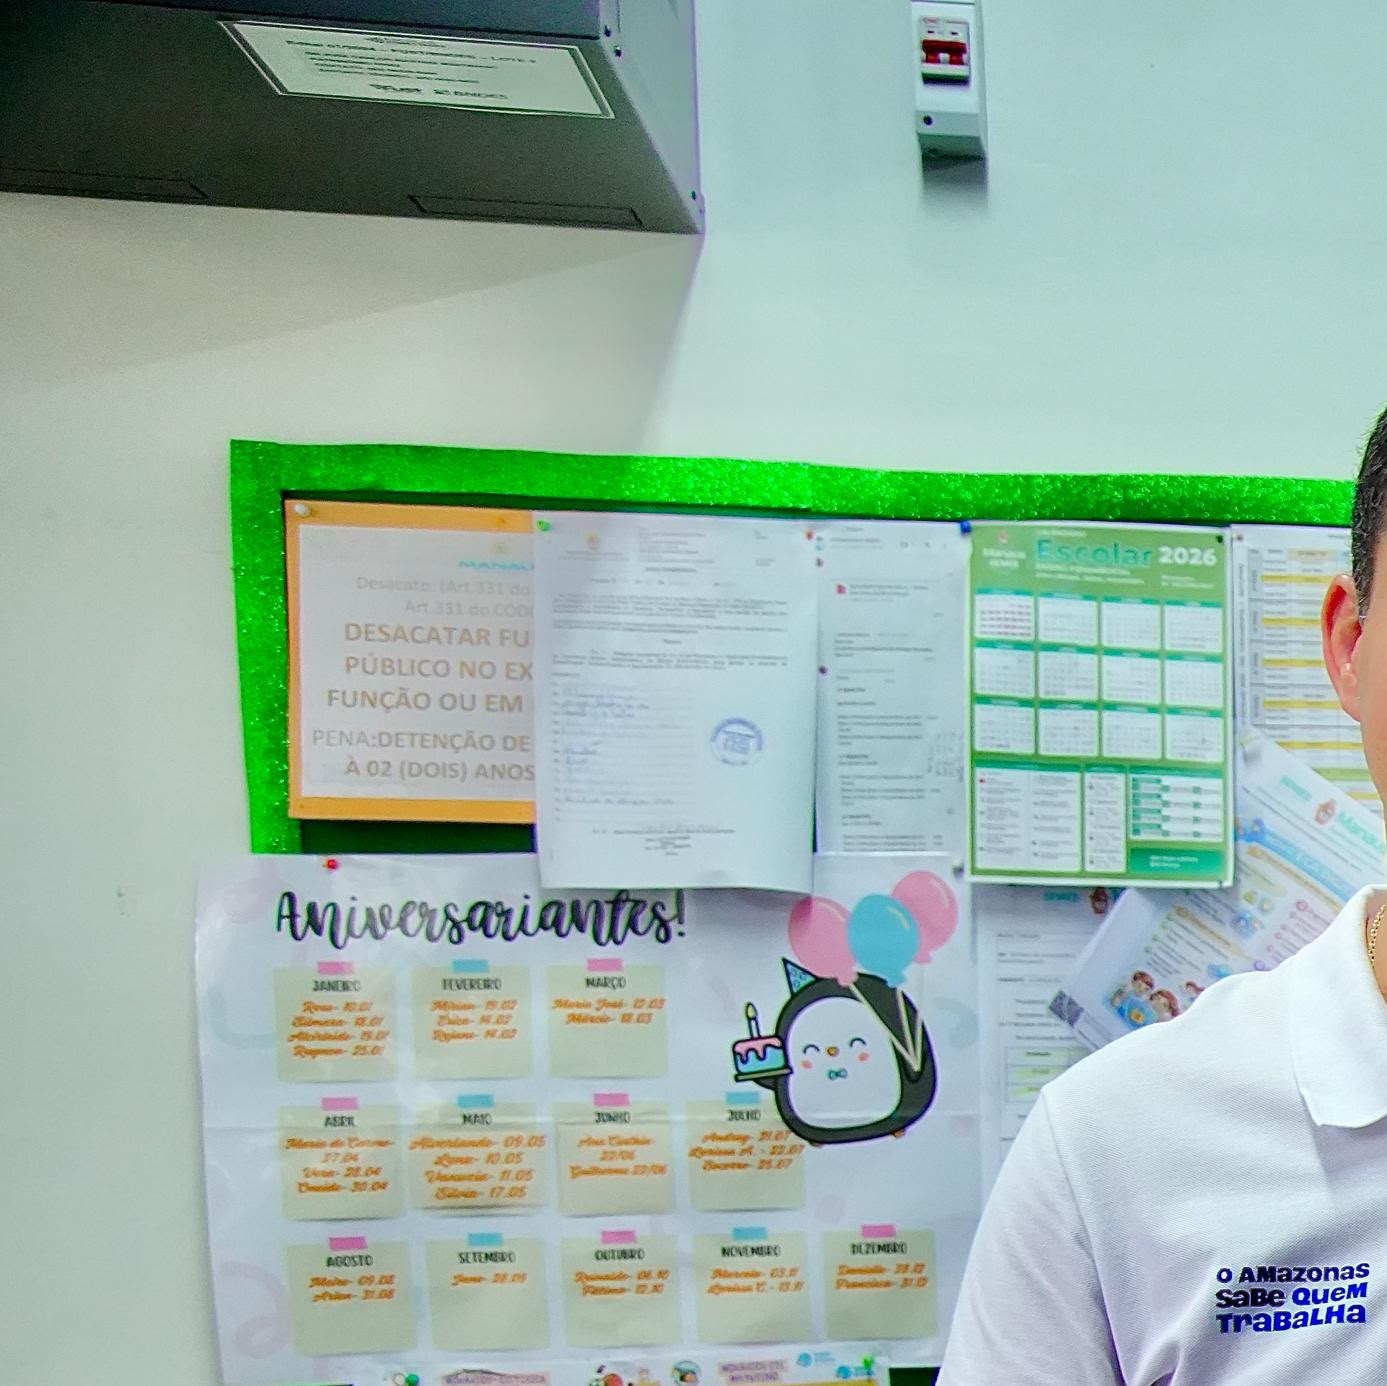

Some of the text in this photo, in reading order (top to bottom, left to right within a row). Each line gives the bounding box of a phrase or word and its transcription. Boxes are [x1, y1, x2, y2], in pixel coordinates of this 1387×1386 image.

[1035, 539, 1216, 566] Escolar 2026
[345, 623, 491, 646] DESACATAR
[345, 653, 451, 677] PÚBLICO
[459, 661, 497, 679] NO
[327, 687, 523, 713] FUNÇÃO OU EM
[503, 736, 530, 752] DE
[367, 761, 392, 776] 02
[400, 760, 468, 782] (DOIS)
[475, 764, 535, 780] ANOS
[274, 888, 688, 951] Aniversariantes!
[313, 980, 361, 991] JANEIRO
[442, 978, 502, 991] FEVEREIRO
[586, 978, 626, 990] MARÇO
[324, 1116, 356, 1127] ABRIL
[462, 1113, 492, 1126] MAIO
[594, 1111, 632, 1123] JUNHO
[727, 1109, 762, 1121] JULHO
[594, 1249, 645, 1262] OUTUBRO
[721, 1245, 782, 1258] NOVEMBRO
[849, 1242, 908, 1256] DEZEMBRO
[326, 1255, 374, 1267] AGOSTO
[458, 1251, 517, 1264] SETEMBRO
